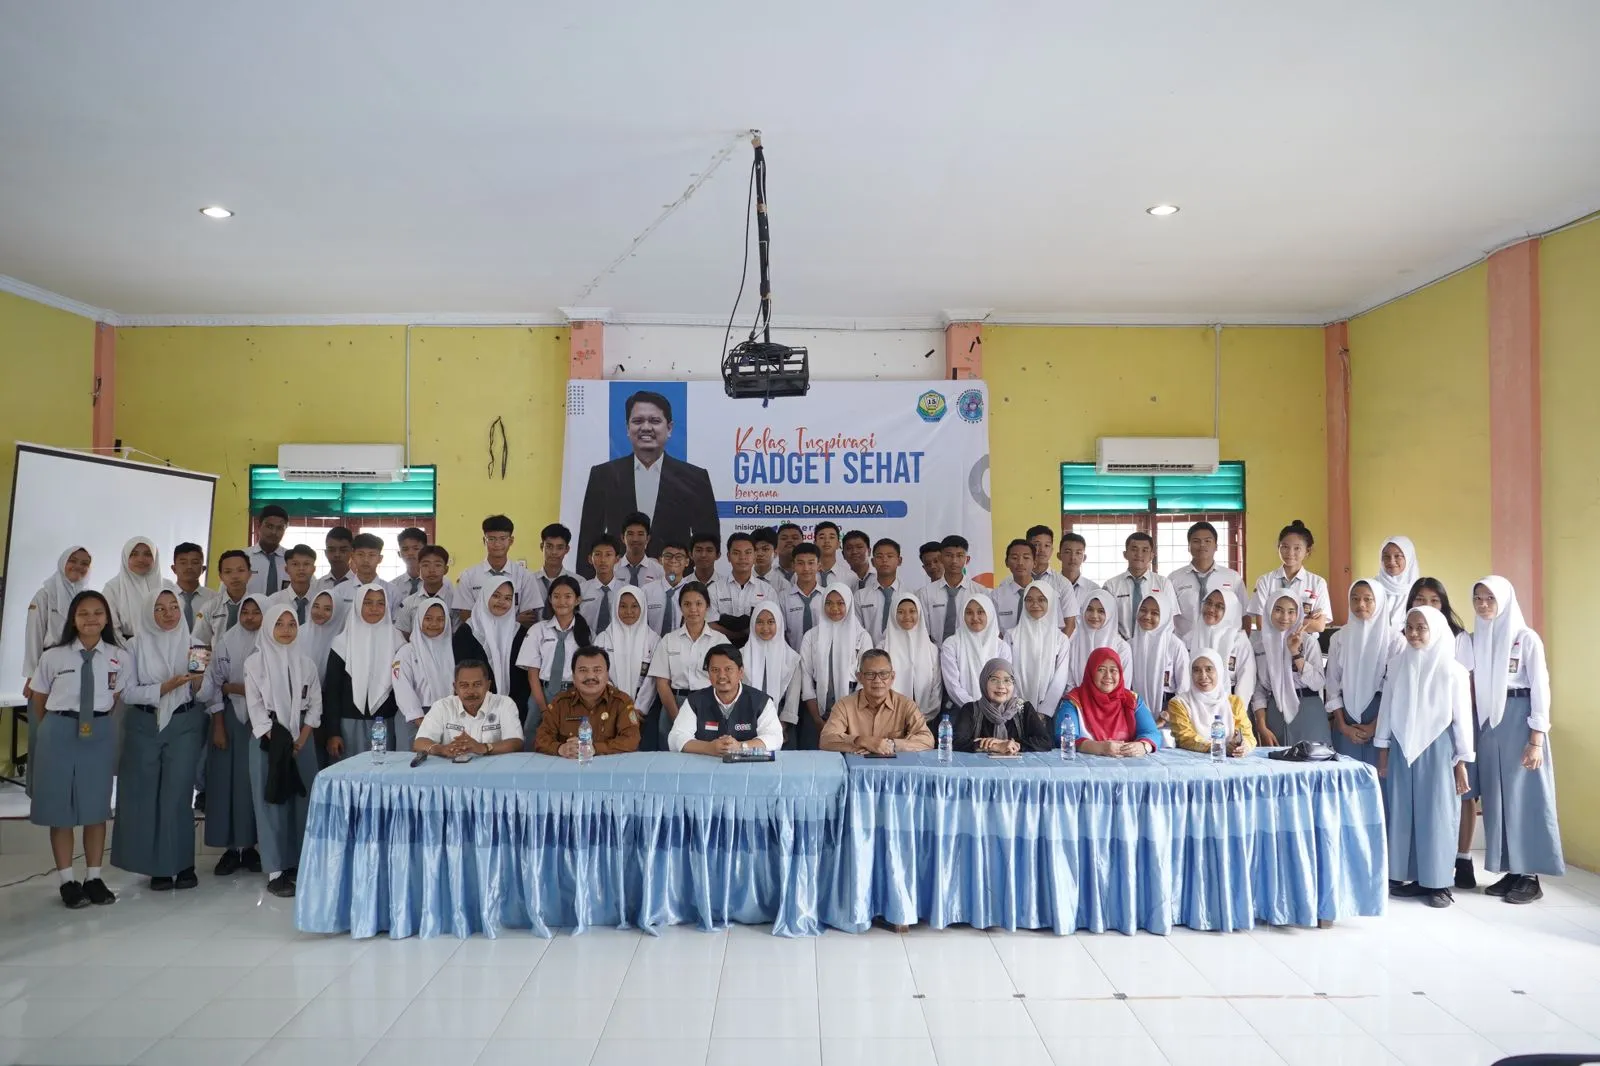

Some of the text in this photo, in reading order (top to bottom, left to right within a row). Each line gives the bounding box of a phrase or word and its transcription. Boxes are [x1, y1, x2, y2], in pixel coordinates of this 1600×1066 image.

[735, 426, 877, 462] Kelas Inspirasi
[734, 451, 925, 484] GADGET SEHAT
[735, 484, 779, 501] bersama
[735, 504, 884, 515] Prof. RIDHA DHARMAJAYA
